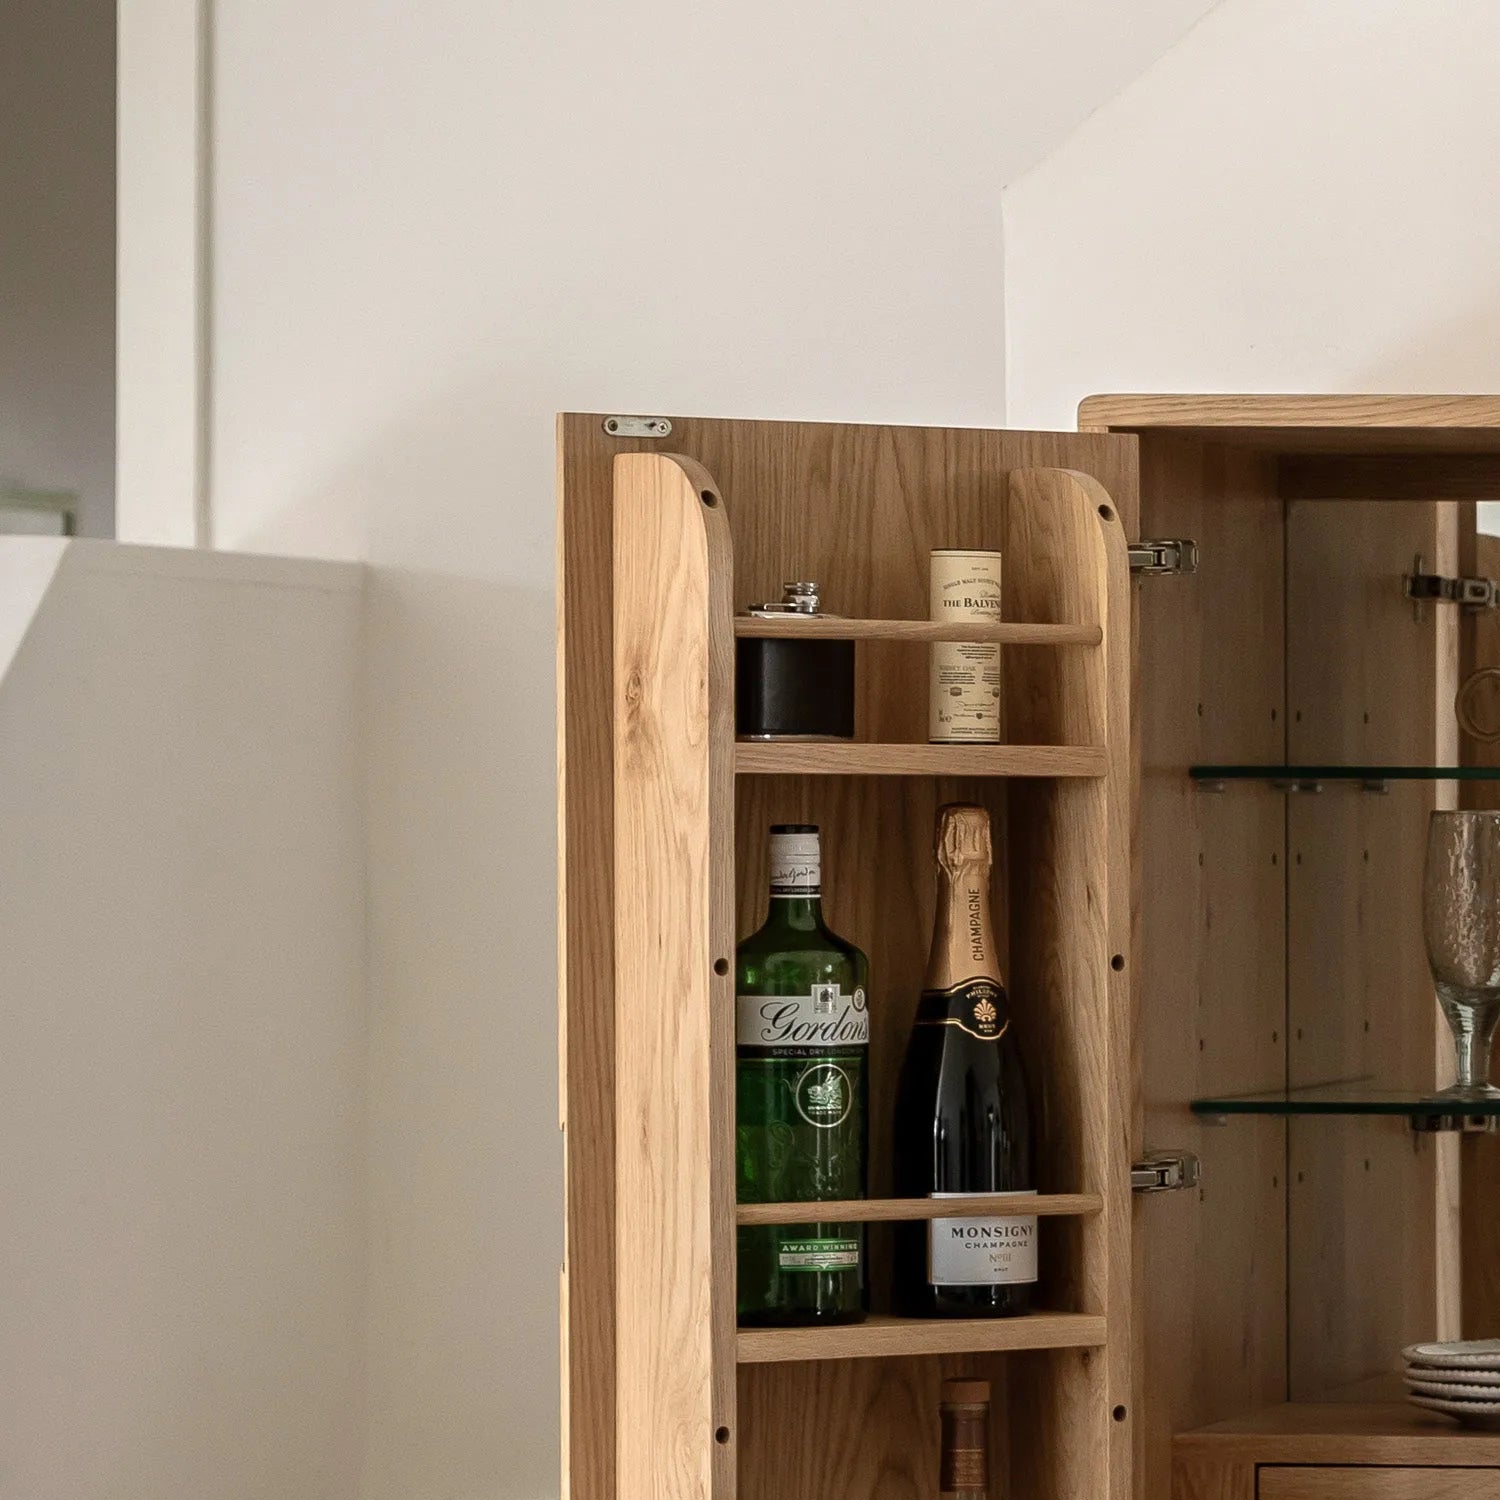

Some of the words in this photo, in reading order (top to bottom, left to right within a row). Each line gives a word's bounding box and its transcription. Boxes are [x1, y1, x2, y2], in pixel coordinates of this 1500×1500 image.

[943, 599, 961, 608] THE
[968, 888, 985, 961] CHAMPAGNE
[772, 1048, 807, 1056] SPECIAL
[809, 1047, 825, 1056] DRY
[951, 1225, 1034, 1239] MONSIGNY
[782, 1244, 819, 1252] AWARD
[964, 1241, 1029, 1250] CHAMPAGNE
